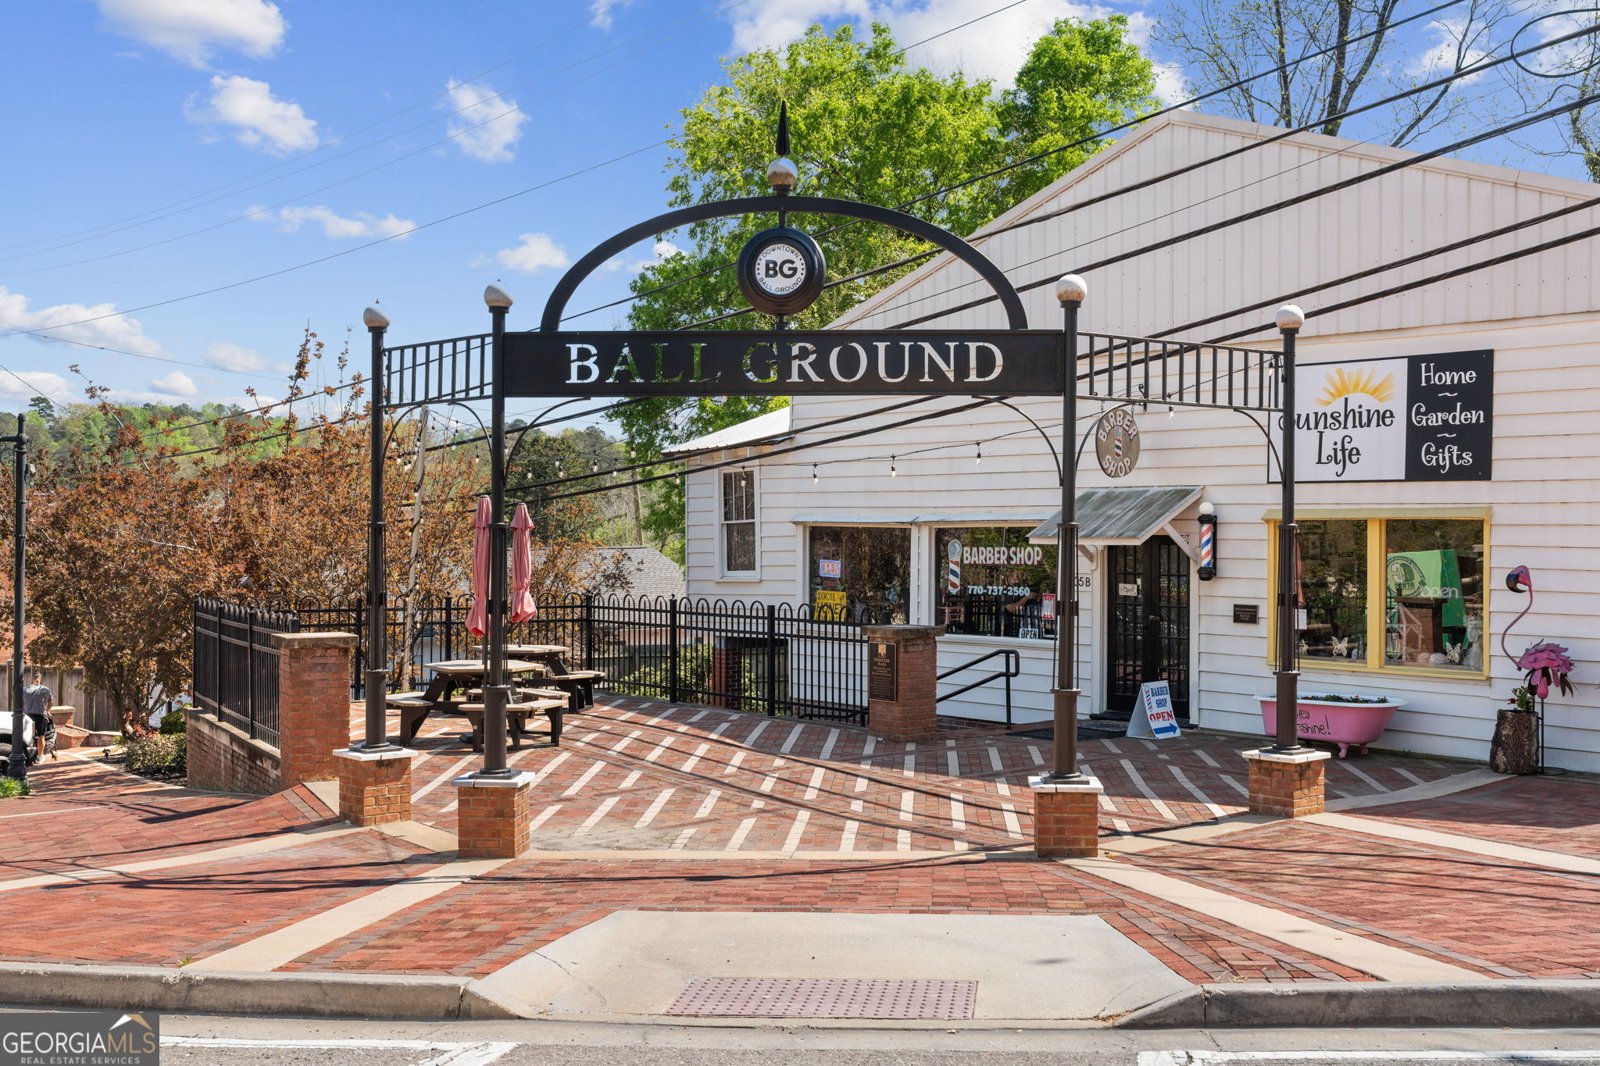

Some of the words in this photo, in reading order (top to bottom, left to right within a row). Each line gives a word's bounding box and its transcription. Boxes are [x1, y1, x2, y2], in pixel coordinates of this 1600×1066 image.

[761, 245, 800, 258] DOWNTOWN
[764, 259, 798, 278] BG
[759, 276, 774, 292] BALL
[774, 277, 801, 293] GROUND
[565, 342, 722, 384] BALL
[742, 341, 1003, 383] GROUND
[1420, 362, 1477, 386] Home
[1411, 402, 1485, 427] Garden
[1098, 410, 1138, 442] BARBER
[1315, 431, 1362, 477] Life
[1421, 442, 1473, 474] Gifts
[1103, 454, 1132, 477] SHOP
[963, 546, 1008, 565] BARBER
[1009, 546, 1043, 565] SHOP
[817, 591, 836, 602] LOCAL
[967, 585, 1031, 597] 770-737-2560
[1149, 711, 1174, 721] OPEN
